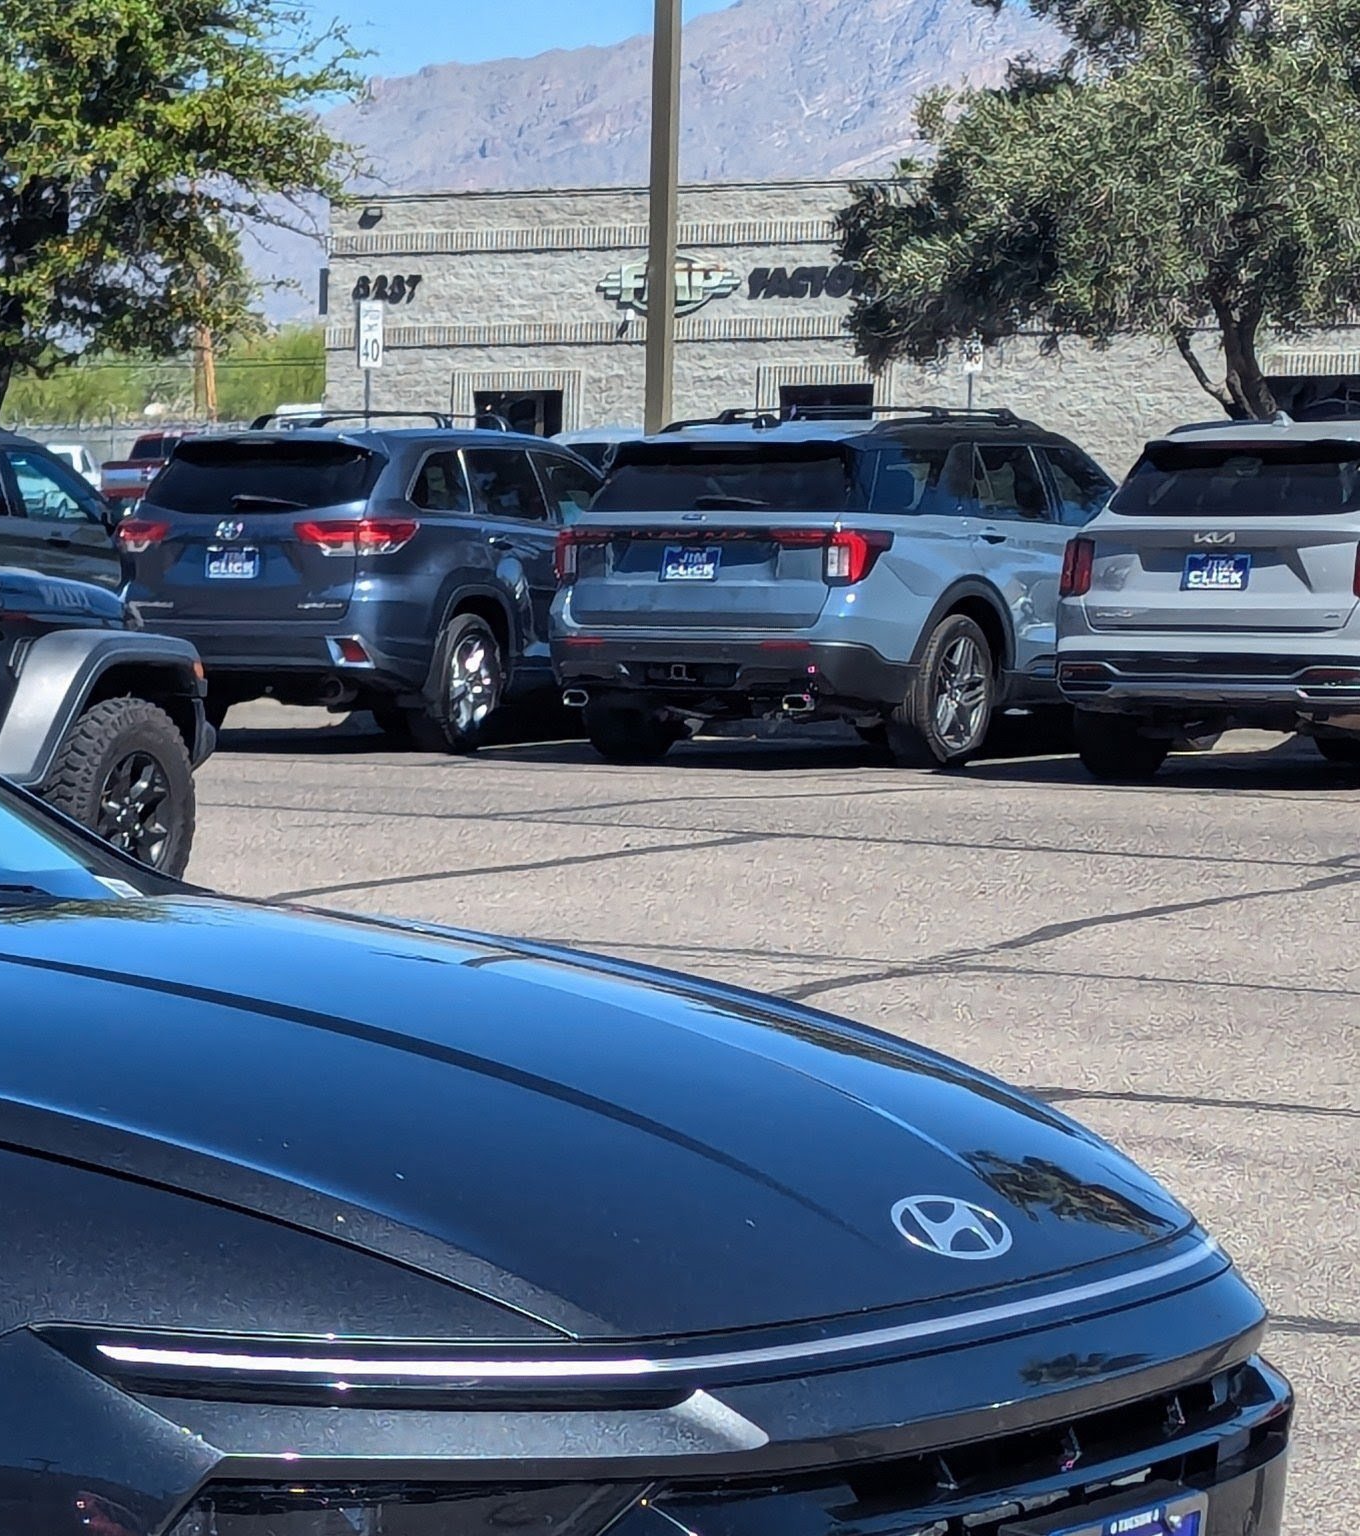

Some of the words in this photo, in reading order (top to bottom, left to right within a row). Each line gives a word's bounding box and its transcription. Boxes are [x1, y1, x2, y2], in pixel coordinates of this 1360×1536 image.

[362, 338, 380, 362] 40
[209, 560, 255, 573] CLICK
[1188, 570, 1243, 584] CLICK
